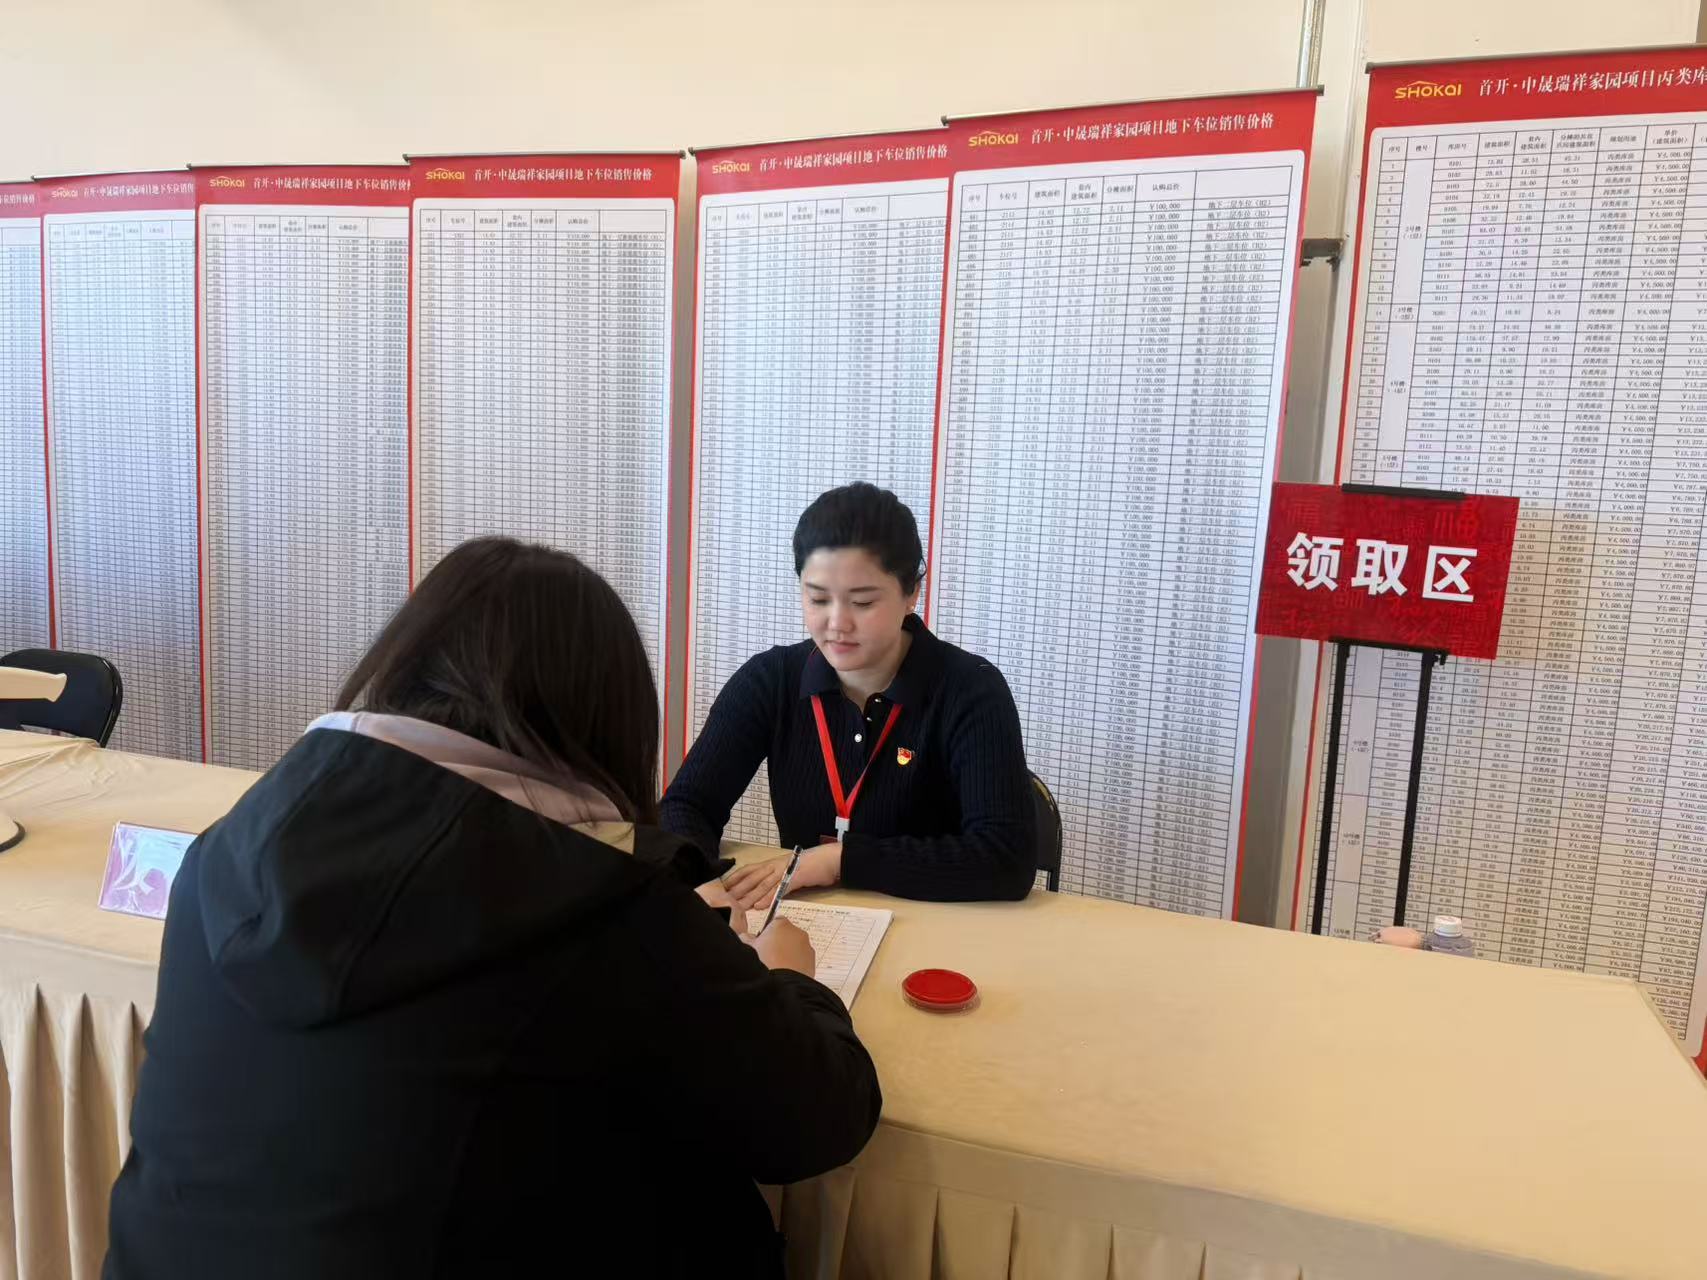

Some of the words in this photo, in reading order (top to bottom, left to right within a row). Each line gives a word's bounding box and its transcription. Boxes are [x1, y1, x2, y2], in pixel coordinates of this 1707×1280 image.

[1032, 113, 1274, 144] 首开·中晟瑞祥家园项目地下车位销售价格
[1286, 532, 1478, 602] 领取区
